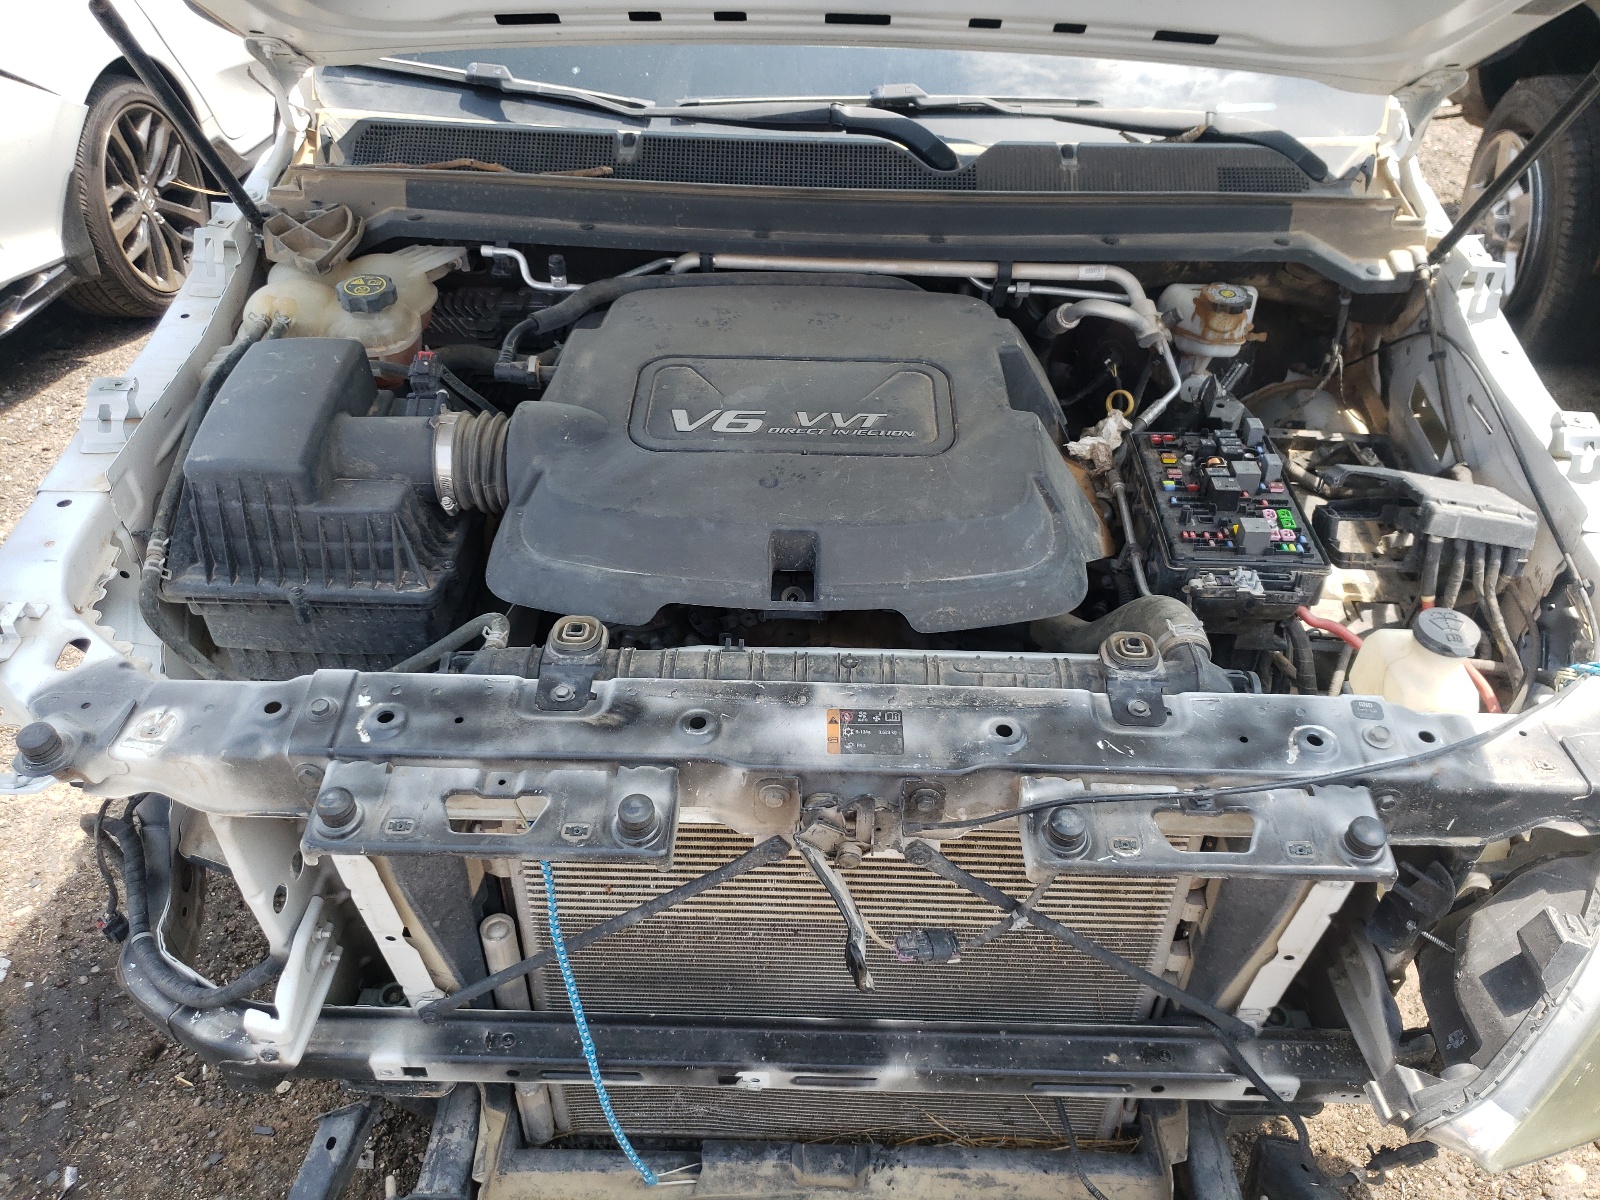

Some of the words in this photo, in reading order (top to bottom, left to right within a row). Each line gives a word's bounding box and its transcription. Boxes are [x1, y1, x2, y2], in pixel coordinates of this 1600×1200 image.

[671, 409, 767, 433] V6
[796, 411, 888, 428] VVT
[767, 427, 828, 435] DIRECT
[832, 429, 915, 437] INJECTION
